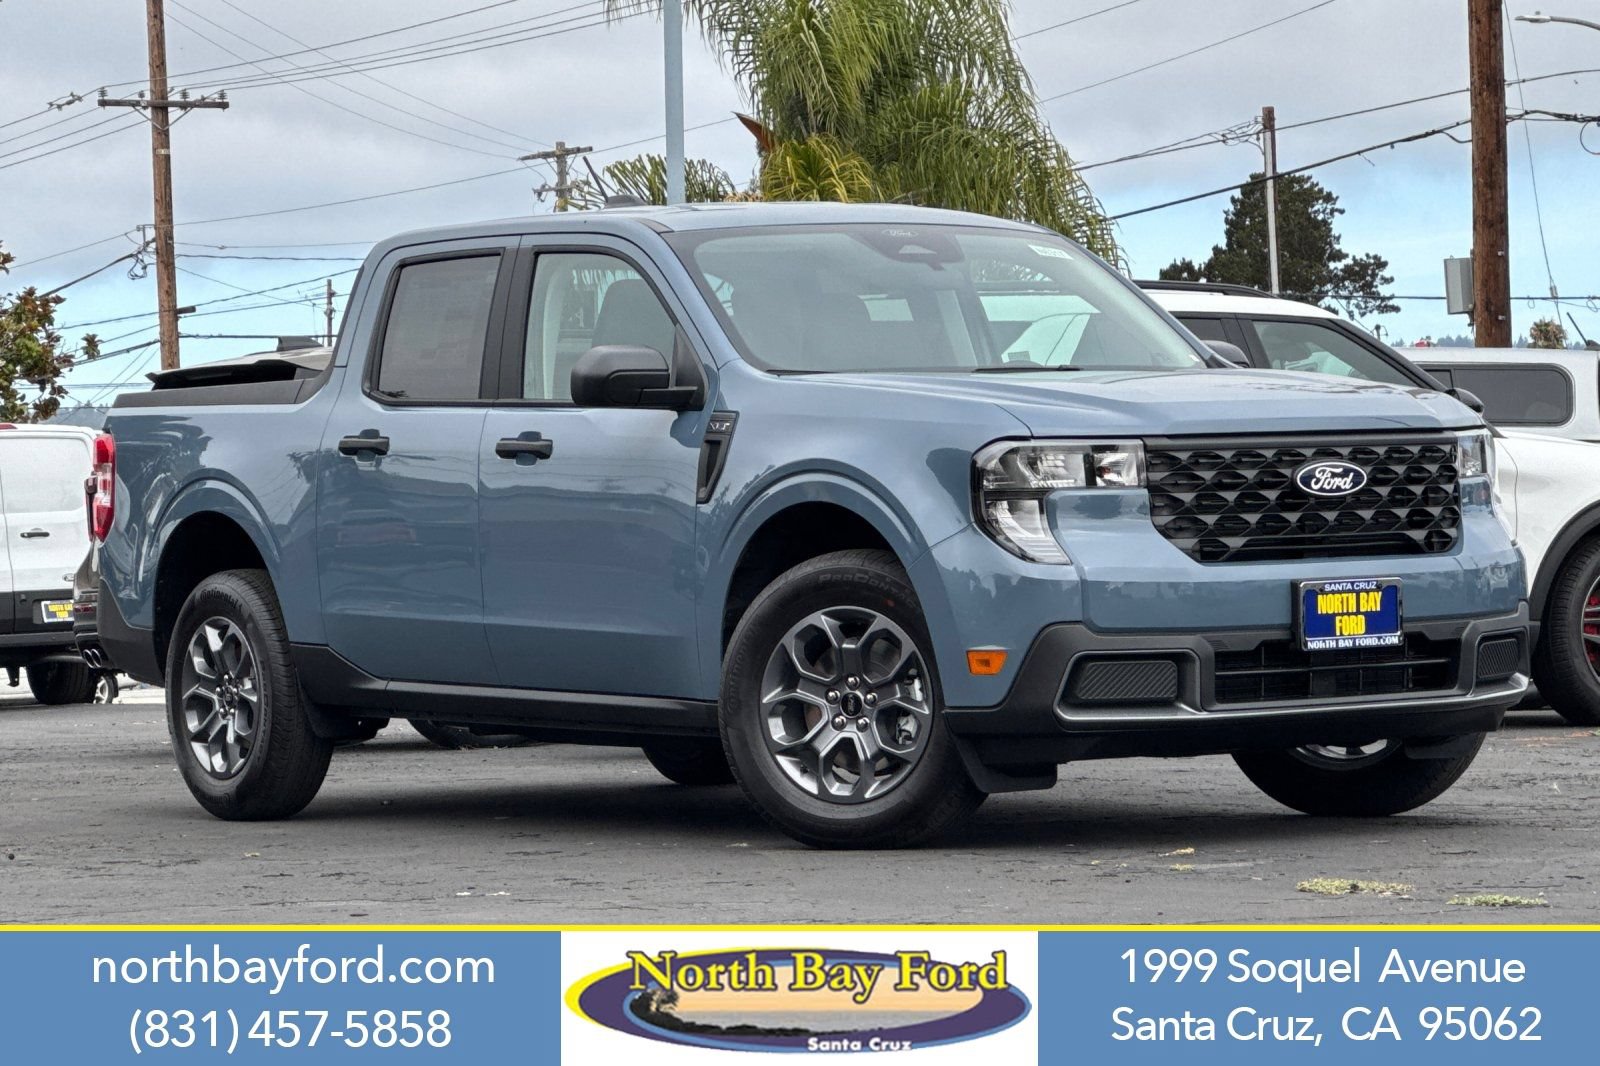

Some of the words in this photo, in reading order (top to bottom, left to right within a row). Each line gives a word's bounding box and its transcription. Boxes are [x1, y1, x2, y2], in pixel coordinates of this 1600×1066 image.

[1310, 466, 1354, 490] Ford
[1324, 582, 1352, 592] SANTA
[1354, 581, 1377, 590] CRUZ
[1317, 593, 1357, 614] NORTH
[1360, 591, 1382, 612] BAY
[1335, 614, 1366, 636] FORD
[1307, 638, 1336, 649] NORTH
[1338, 638, 1354, 648] BAY
